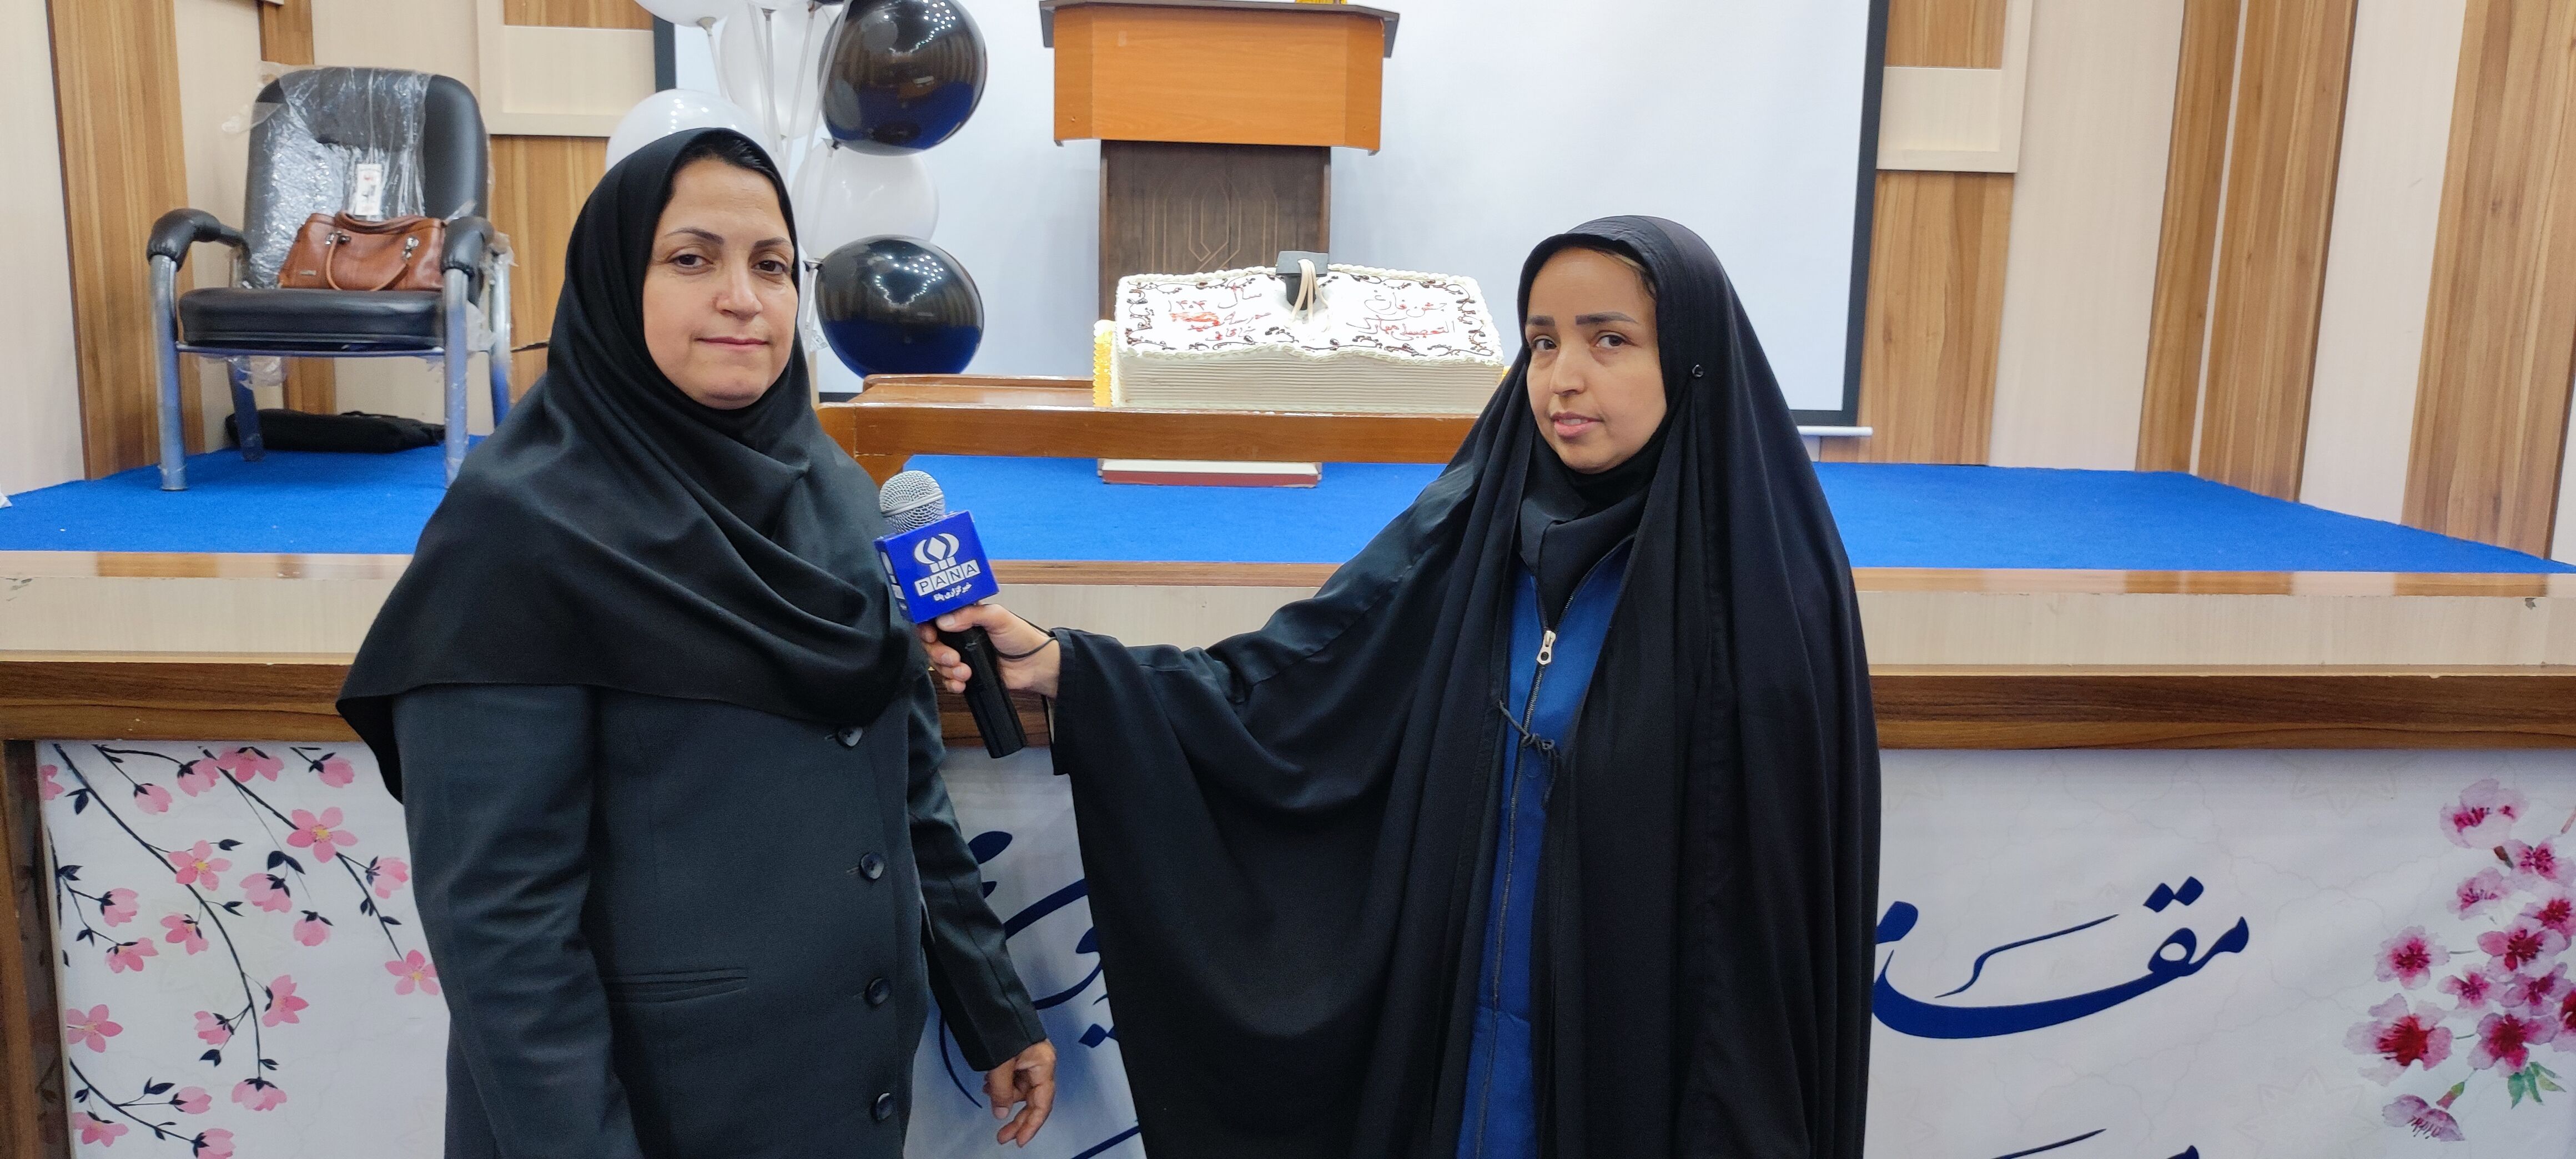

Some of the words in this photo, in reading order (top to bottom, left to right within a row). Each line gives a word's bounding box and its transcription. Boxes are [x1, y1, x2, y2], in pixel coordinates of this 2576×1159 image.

[1217, 283, 1262, 309] سال
[1364, 289, 1407, 316] فارغ
[918, 563, 978, 593] PANA
